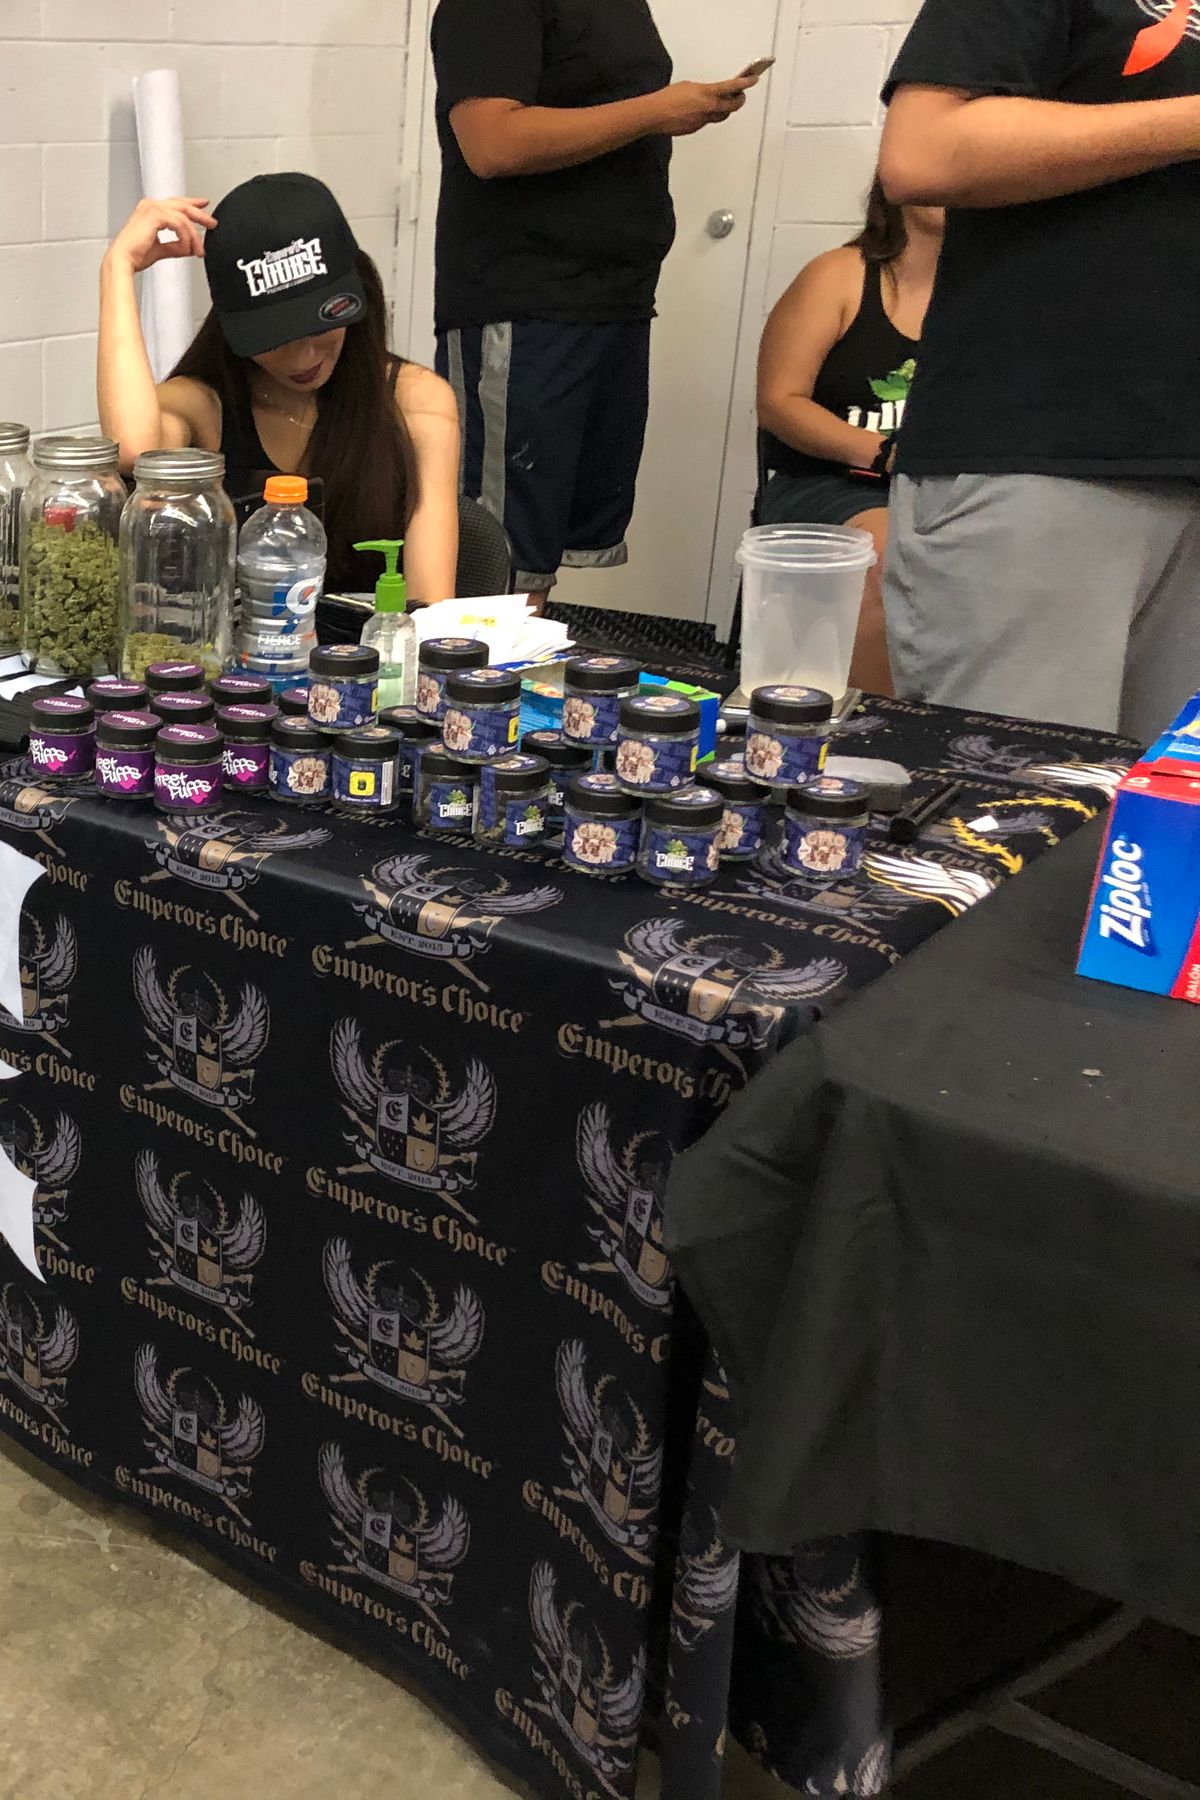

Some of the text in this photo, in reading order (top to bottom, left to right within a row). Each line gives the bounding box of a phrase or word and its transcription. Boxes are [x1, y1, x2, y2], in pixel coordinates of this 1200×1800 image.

[1100, 839, 1152, 947] Ziploc
[220, 913, 288, 957] Choice
[441, 983, 524, 1033] Choice
[217, 1130, 284, 1176] Choice
[432, 1214, 508, 1267] Choice
